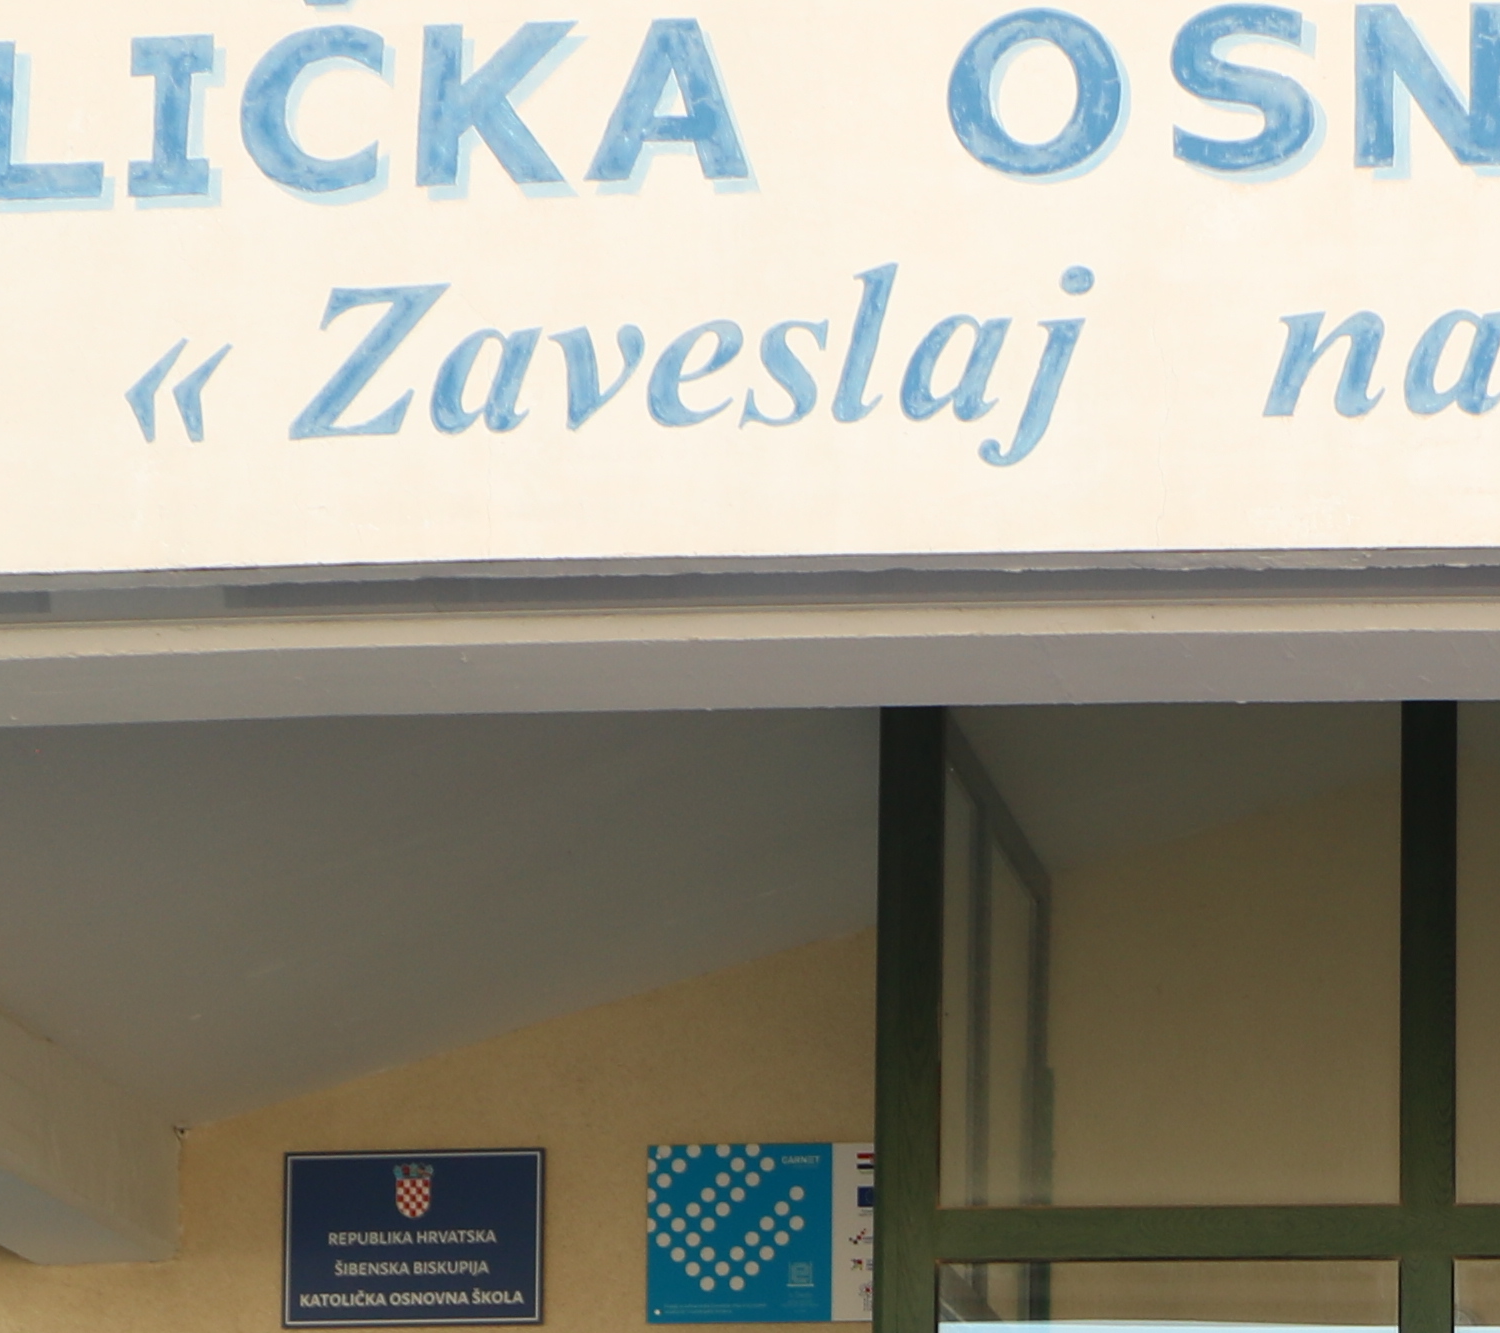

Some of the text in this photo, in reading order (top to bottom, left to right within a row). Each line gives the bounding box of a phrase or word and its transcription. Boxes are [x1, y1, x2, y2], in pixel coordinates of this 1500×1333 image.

[288, 262, 1096, 467] Zaveslaj
[328, 1229, 497, 1246] REPUBLIKA HRVATSKA
[334, 1259, 490, 1277] ŠIBENSKA BISKUPIJA
[300, 1287, 525, 1307] KATOLIČKA OSNOVNA ŠKOLA
